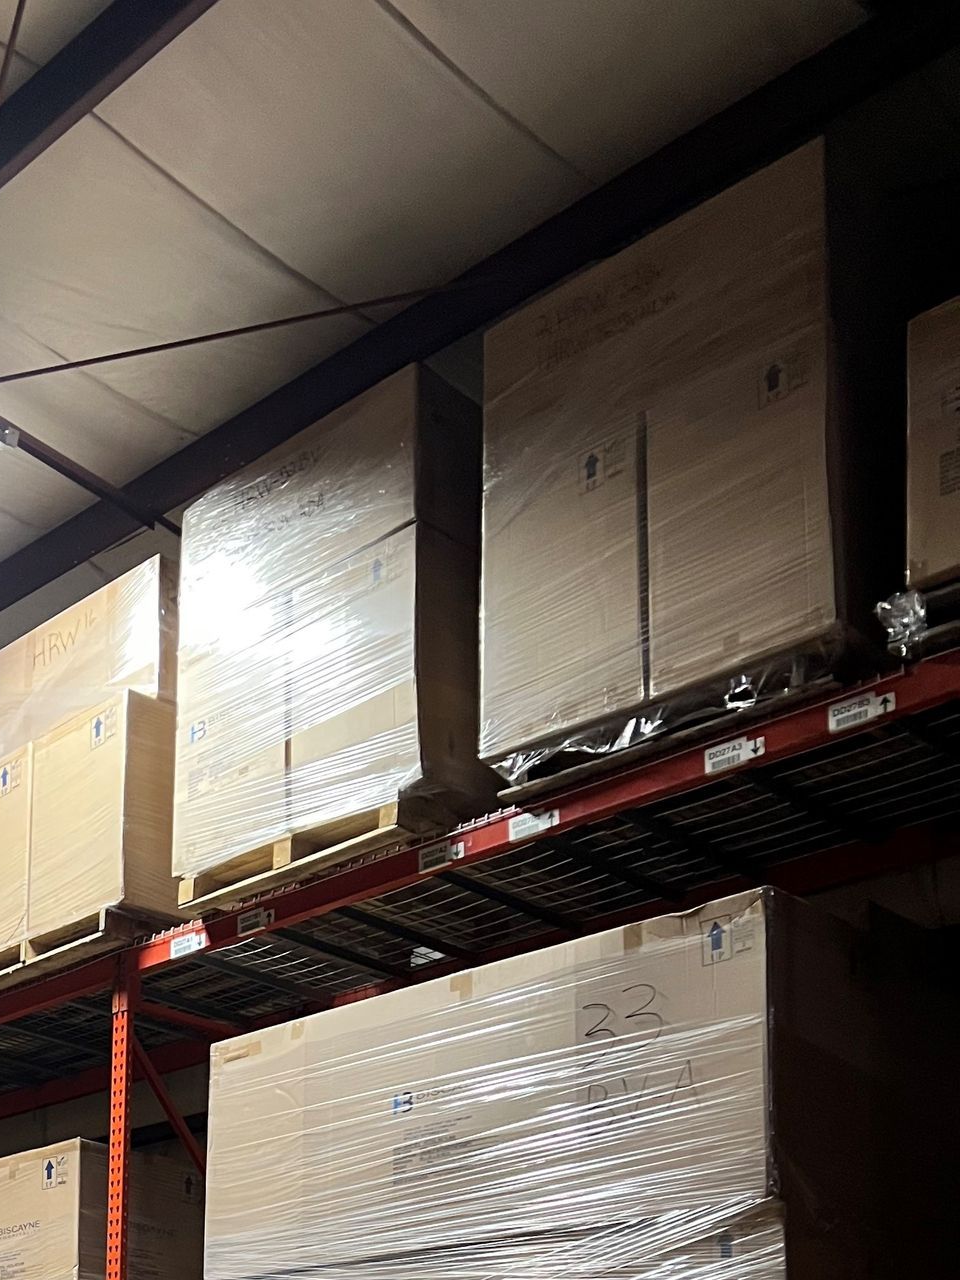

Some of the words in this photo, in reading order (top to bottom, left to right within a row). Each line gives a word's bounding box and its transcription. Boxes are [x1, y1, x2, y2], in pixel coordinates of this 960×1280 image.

[33, 618, 80, 669] HRW
[708, 742, 743, 761] DD27A3
[582, 984, 665, 1069] 33
